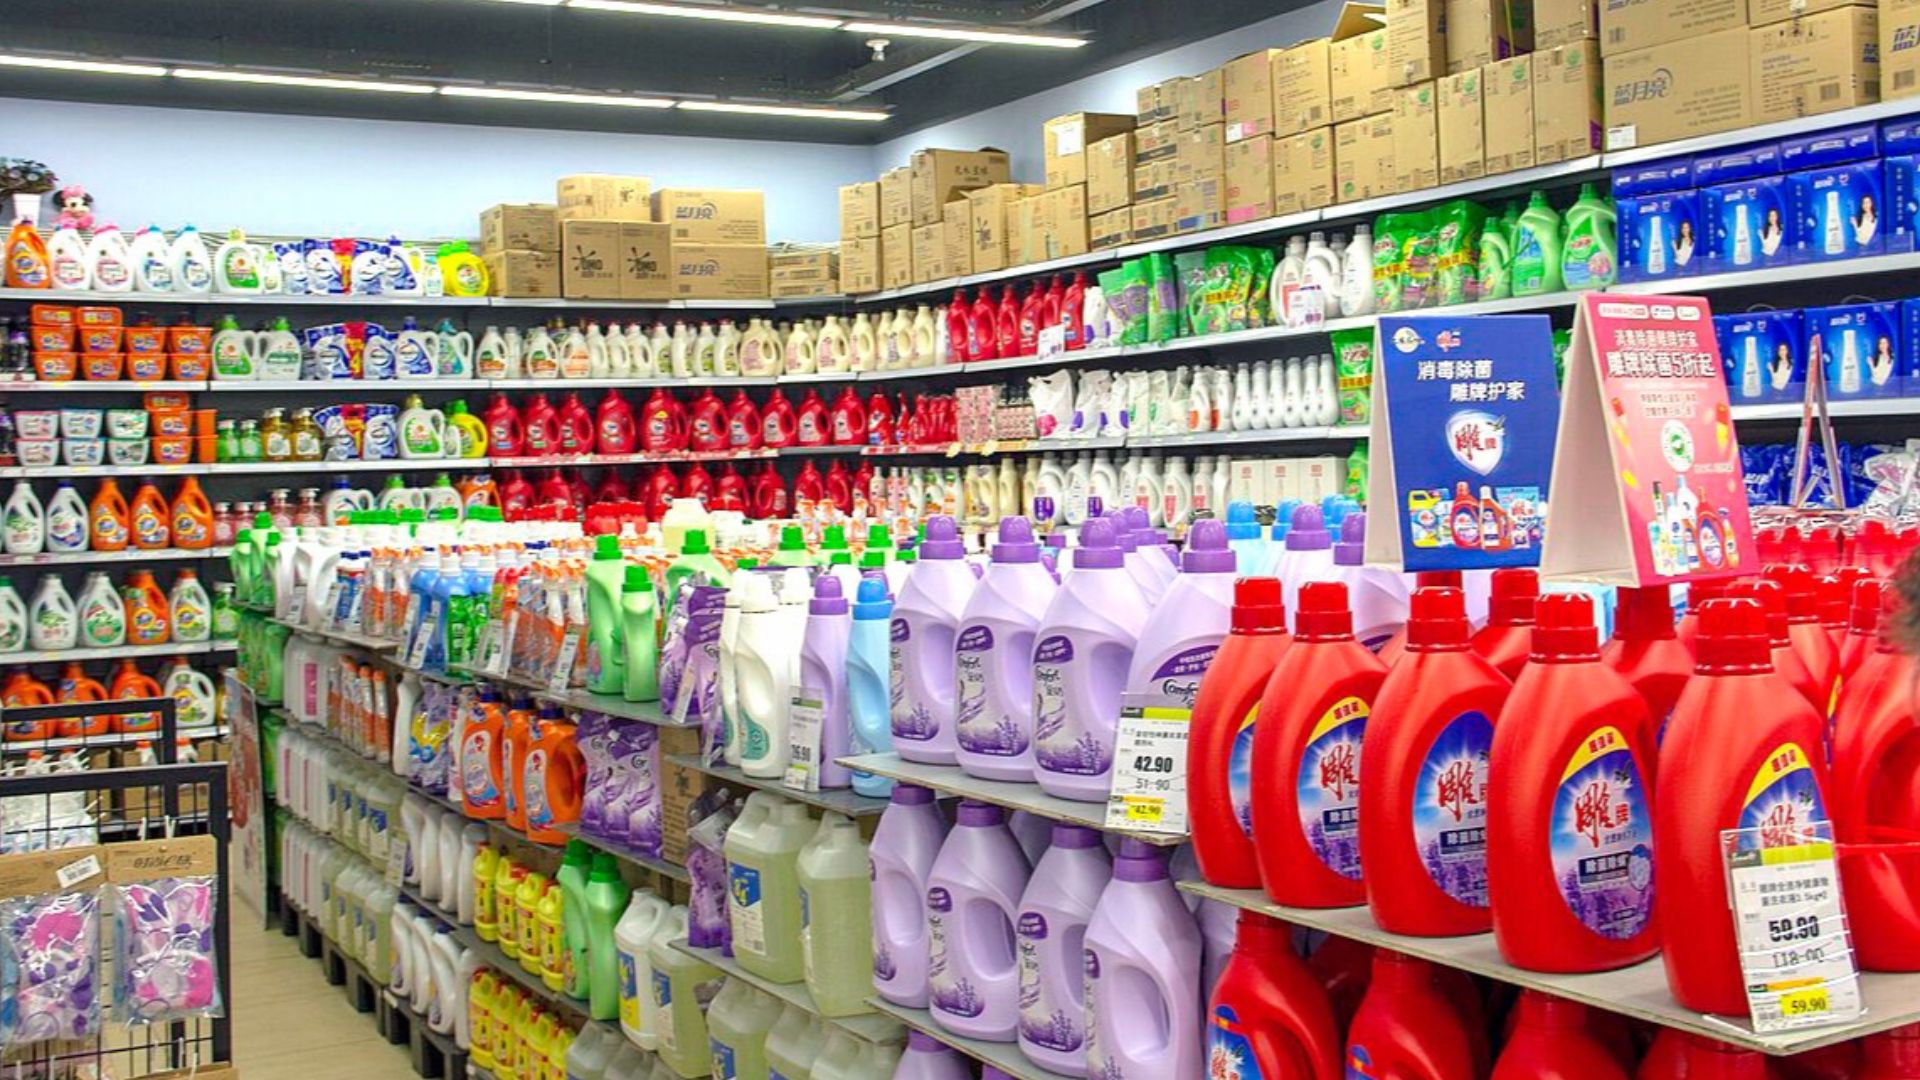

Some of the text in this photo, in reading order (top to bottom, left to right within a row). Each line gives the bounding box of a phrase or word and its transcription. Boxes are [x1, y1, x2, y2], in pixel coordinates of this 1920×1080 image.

[1614, 73, 1670, 105] 蓝月亮
[1417, 360, 1493, 380] 消毒除菌
[1606, 352, 1716, 378] 雕牌除菌5折起
[1450, 382, 1525, 401] 雕牌护家
[1134, 756, 1173, 773] 42.90
[1768, 916, 1819, 942] 59.90
[1791, 998, 1827, 1013] 59.90
